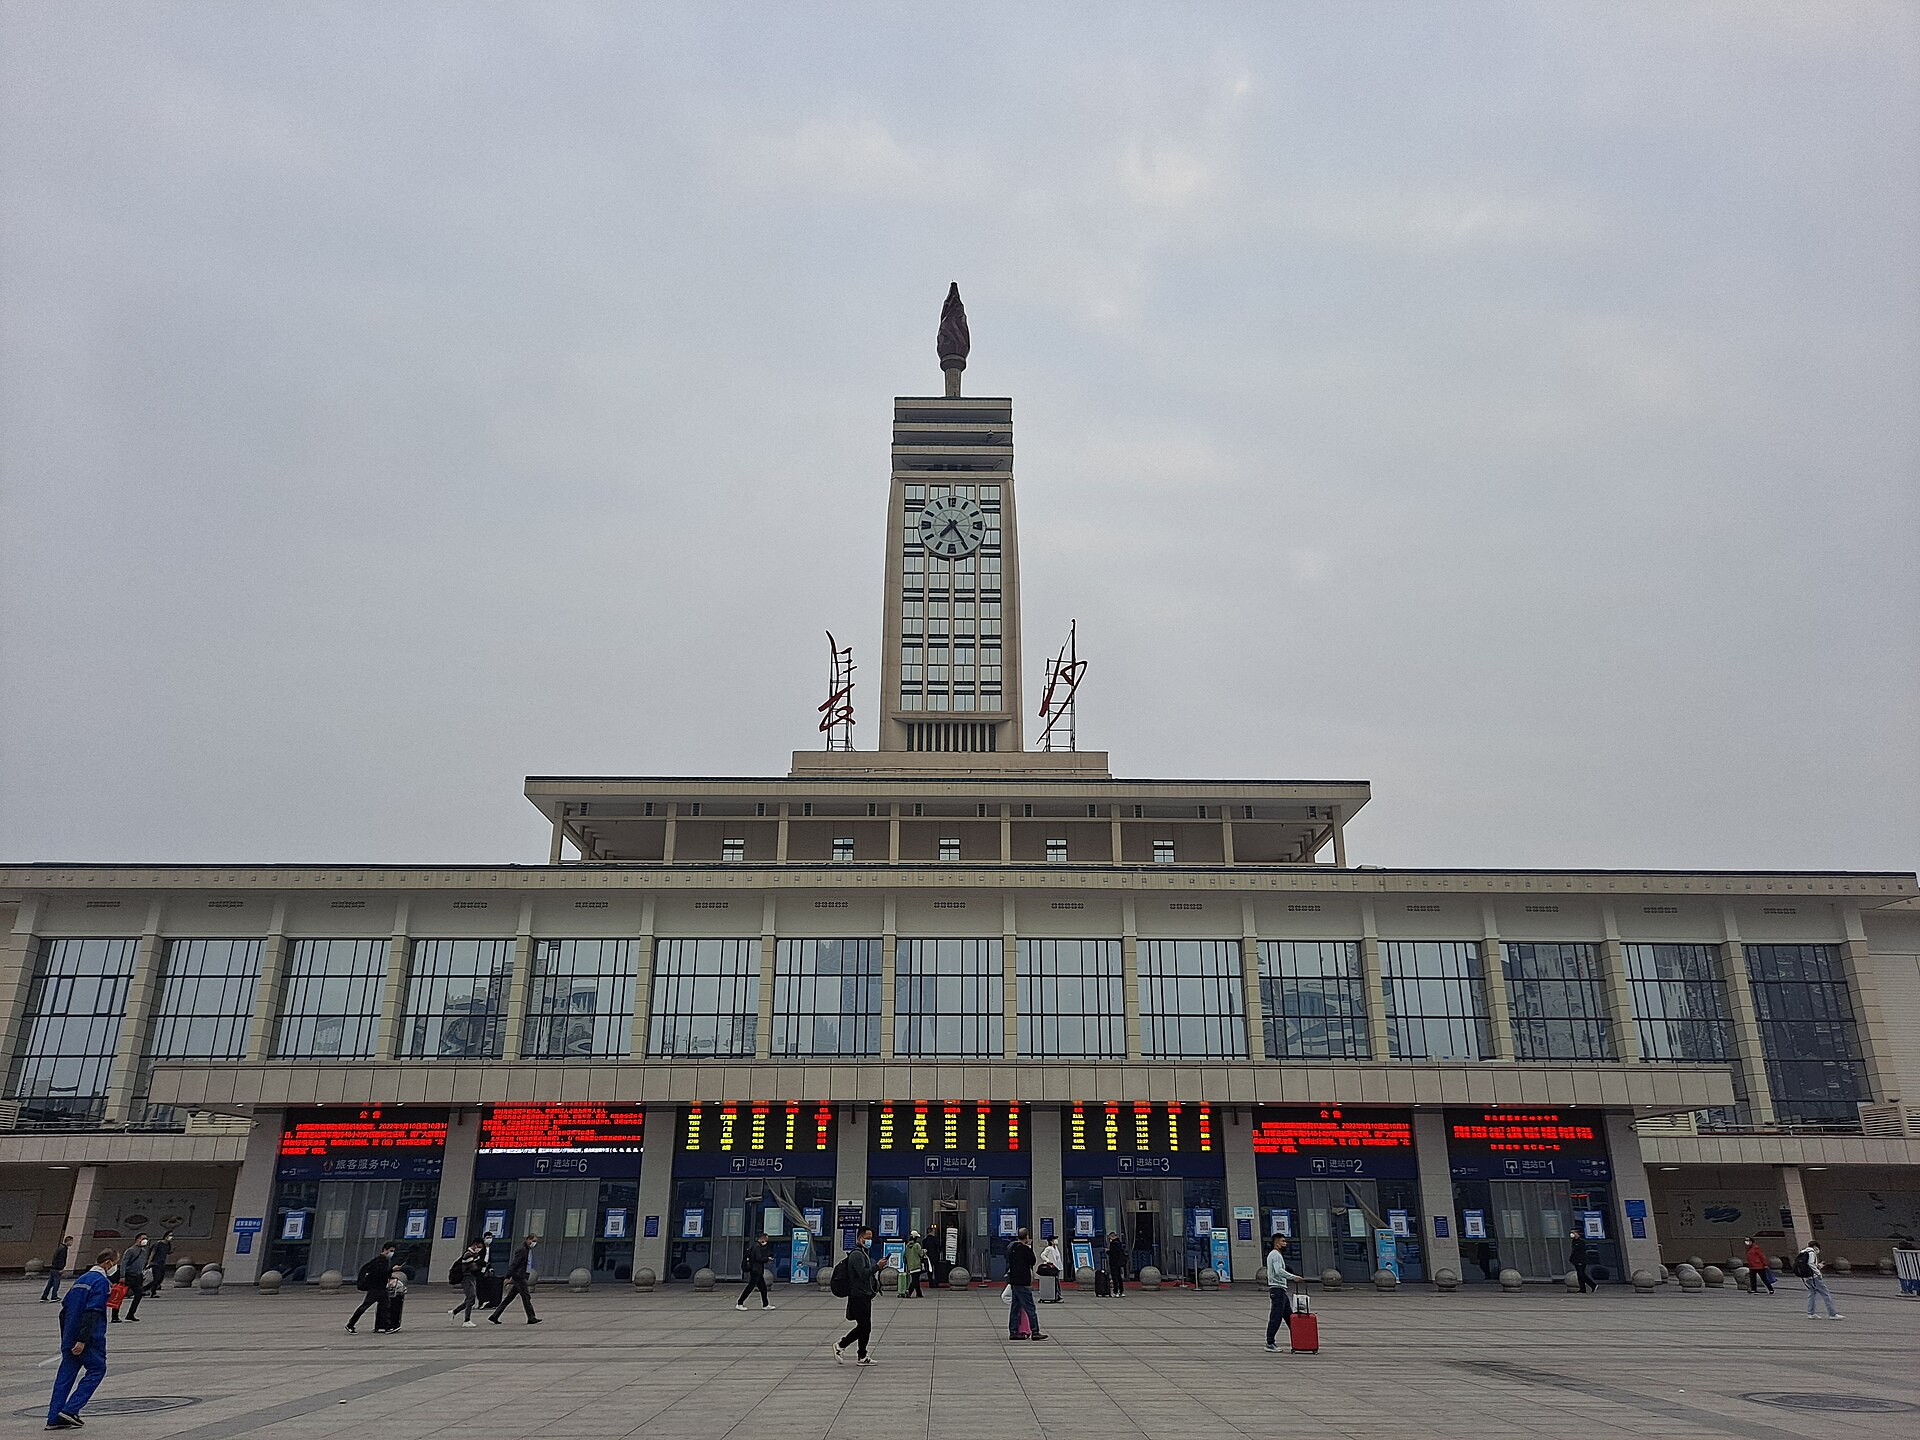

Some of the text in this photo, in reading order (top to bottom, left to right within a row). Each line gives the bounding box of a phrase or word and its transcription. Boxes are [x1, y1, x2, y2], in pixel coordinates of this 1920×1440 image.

[335, 1158, 401, 1170] 旅客服务中心
